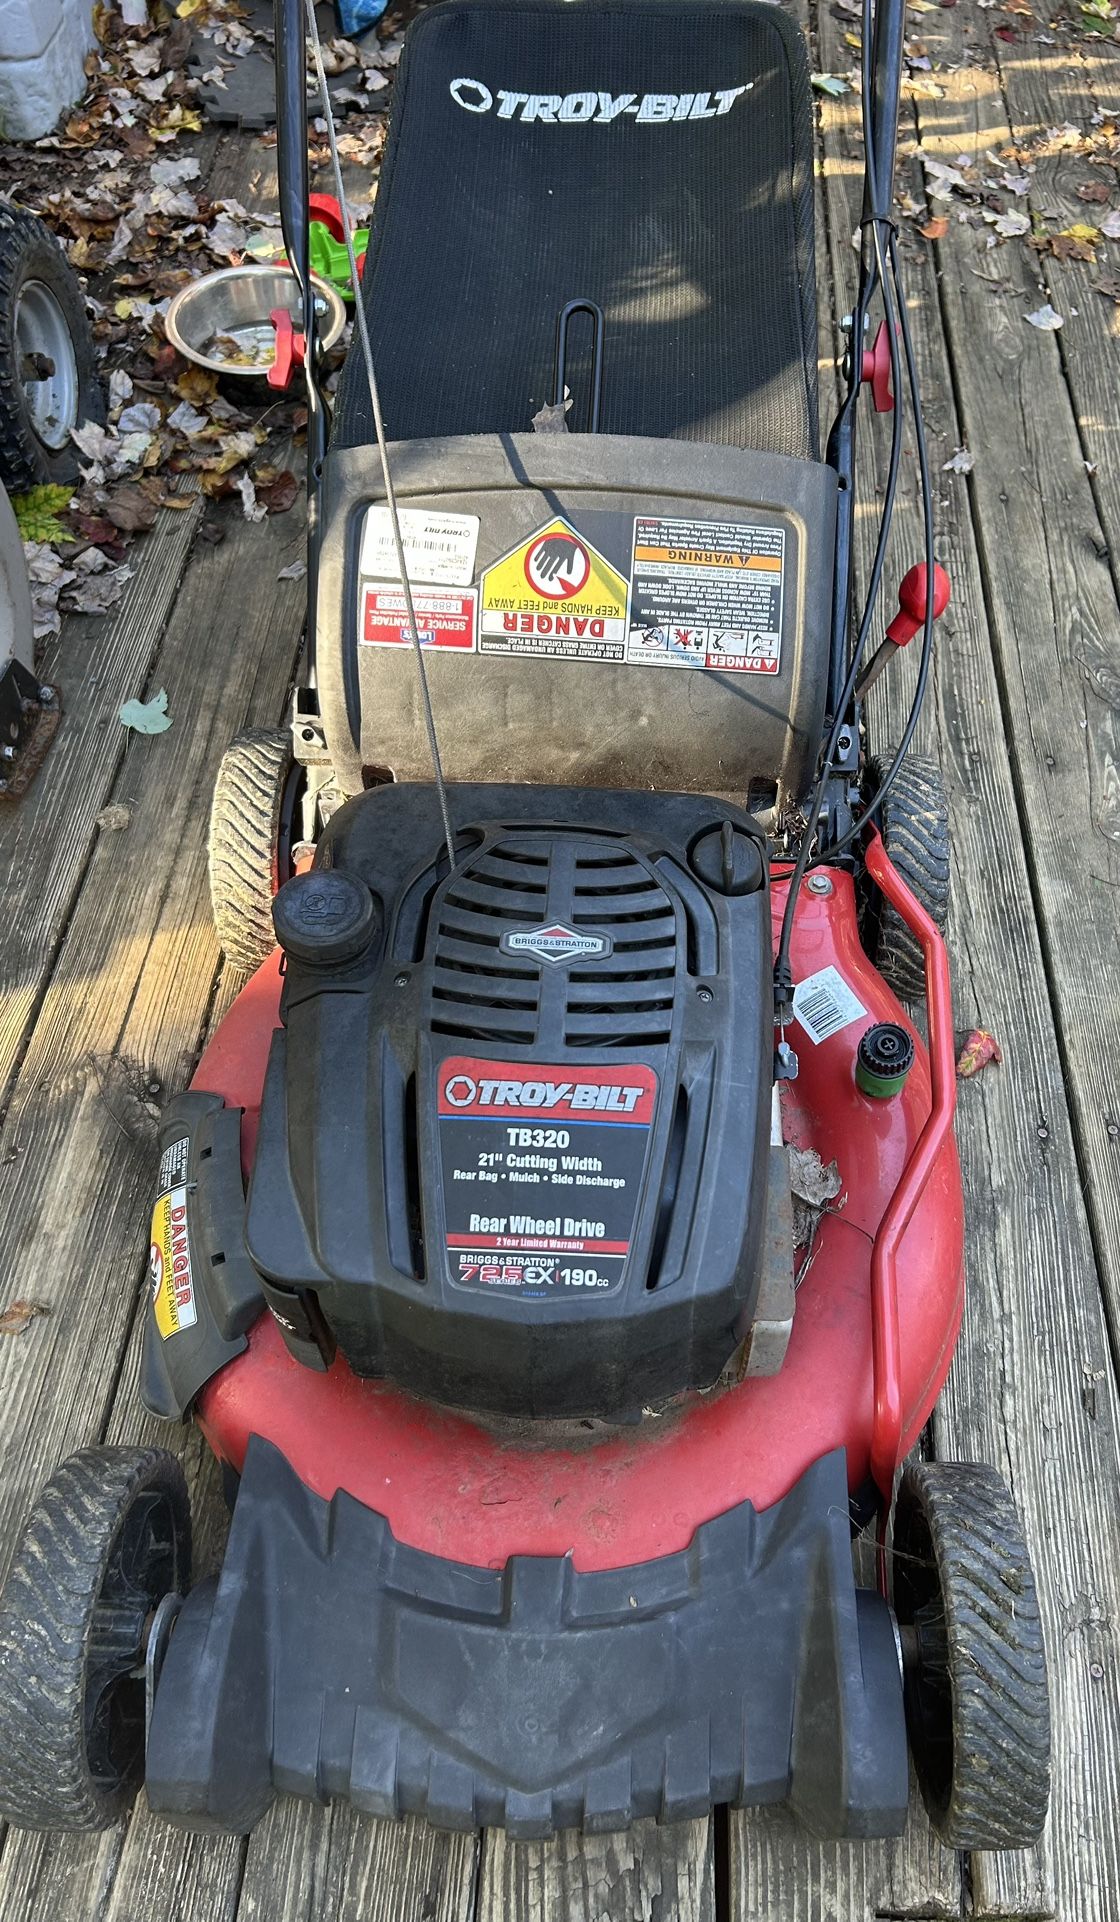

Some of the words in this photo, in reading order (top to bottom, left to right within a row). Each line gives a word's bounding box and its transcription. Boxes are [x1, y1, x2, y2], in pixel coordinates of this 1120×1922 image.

[497, 87, 748, 122] TROY-BILT
[667, 549, 733, 563] WARNING
[488, 597, 515, 609] AWAY
[517, 599, 540, 611] FEET
[542, 601, 559, 611] and
[561, 602, 593, 614] HANDS
[595, 605, 619, 616] KEEP
[427, 619, 465, 631] SERVICE
[502, 611, 604, 638] DANGER
[481, 641, 510, 650] DISCHARGE
[505, 636, 523, 644] PLACE.
[538, 639, 560, 647] CATCHER
[511, 644, 545, 652] UNDAMAGED
[555, 647, 576, 655] UNLESS
[577, 649, 601, 657] OPERATE
[709, 654, 761, 668] DANGER
[515, 938, 597, 948] BRIGGS&STRATTON
[478, 1079, 644, 1112] TROY-BILT
[507, 1128, 570, 1149] TB320
[478, 1153, 502, 1166] 21"
[506, 1154, 557, 1171] Cutting
[562, 1156, 602, 1171] Width
[454, 1170, 476, 1181] Rear
[478, 1171, 498, 1183] Bag
[509, 1172, 540, 1183] Mulch
[552, 1174, 575, 1185] Side
[576, 1175, 626, 1188] Discharge
[470, 1213, 507, 1232] Rear
[509, 1216, 560, 1236] Wheel
[563, 1218, 606, 1237] Drive
[163, 1224, 171, 1255] HANDS
[496, 1237, 502, 1246] 2
[502, 1238, 519, 1247] Year
[520, 1238, 548, 1248] Limited
[549, 1239, 584, 1250] Warranty
[172, 1205, 191, 1307] DANGER
[164, 1256, 172, 1273] and
[459, 1264, 522, 1282] 725
[523, 1267, 555, 1284] EX
[166, 1274, 174, 1296] FEET
[168, 1299, 178, 1326] AWAY
